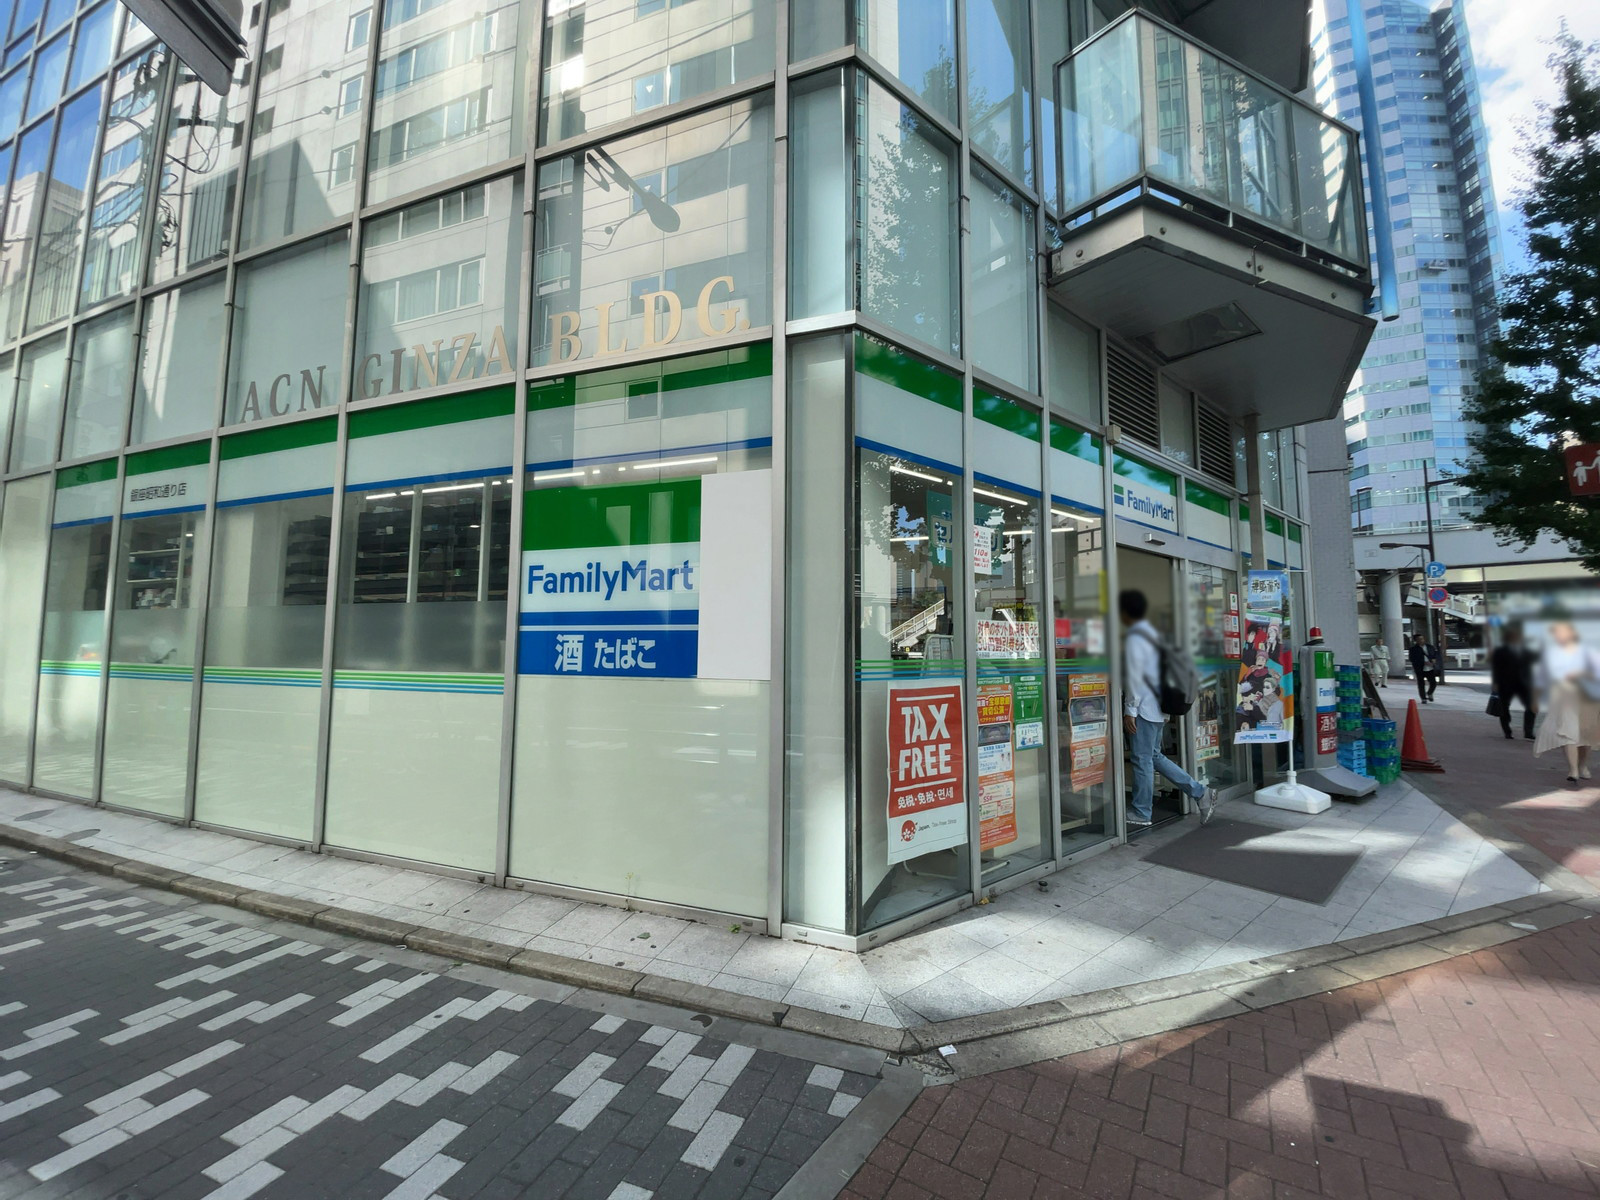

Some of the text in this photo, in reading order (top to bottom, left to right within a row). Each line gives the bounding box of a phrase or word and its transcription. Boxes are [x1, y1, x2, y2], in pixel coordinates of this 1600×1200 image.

[241, 275, 752, 423] ACN GINZA BLDG.
[1127, 489, 1175, 522] FamilyMart
[527, 560, 694, 601] FamilyMart
[1430, 565, 1439, 578] P
[554, 633, 657, 672] 酒 たばこ
[901, 703, 951, 745] TAX
[898, 743, 952, 781] FREE
